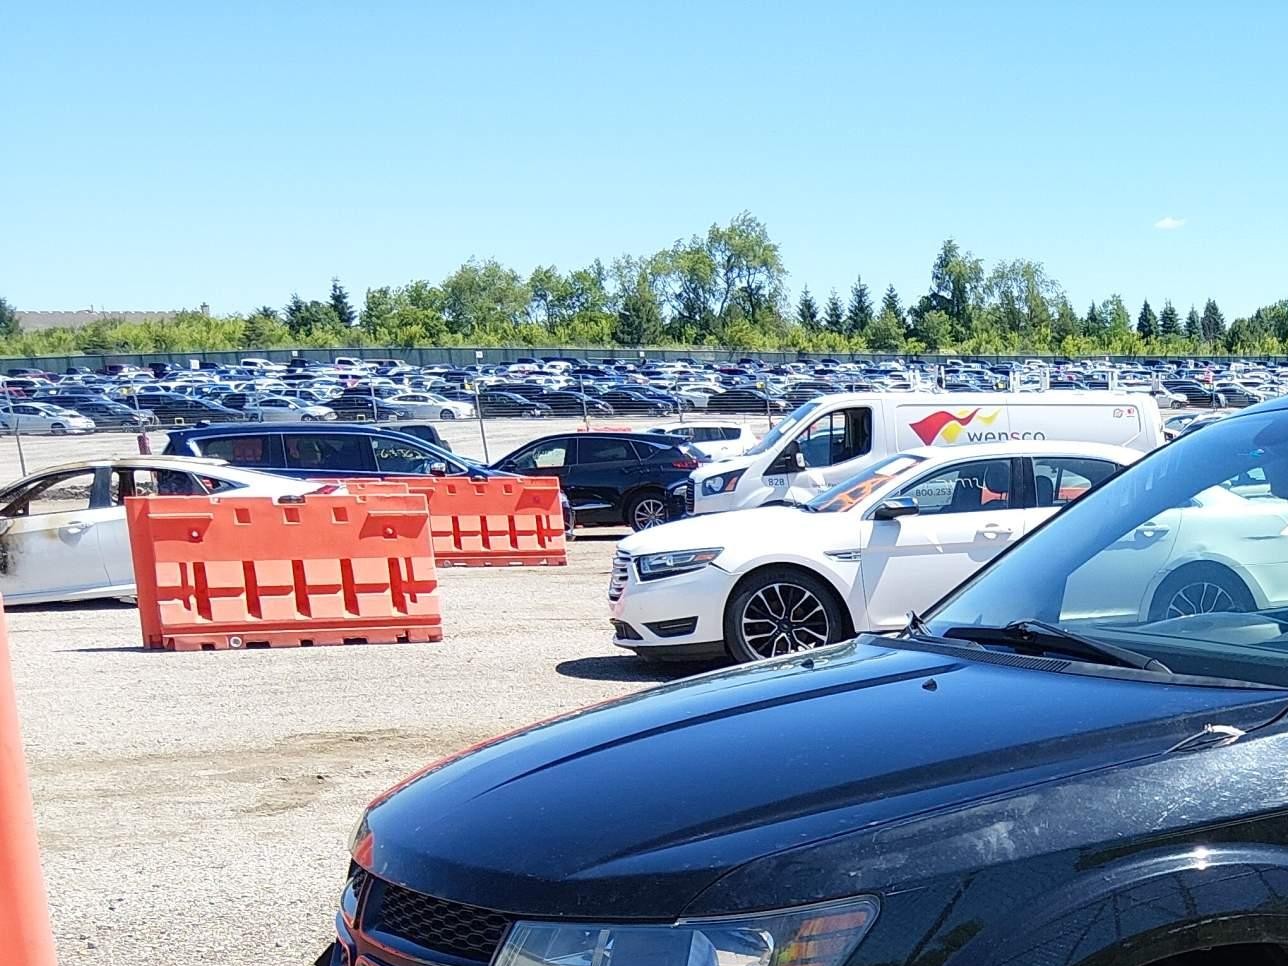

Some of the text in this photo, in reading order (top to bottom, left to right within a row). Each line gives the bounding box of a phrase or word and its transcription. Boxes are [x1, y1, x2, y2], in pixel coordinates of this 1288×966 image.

[967, 431, 1046, 442] wensco
[767, 478, 785, 487] 828
[915, 488, 952, 497] 800.253
